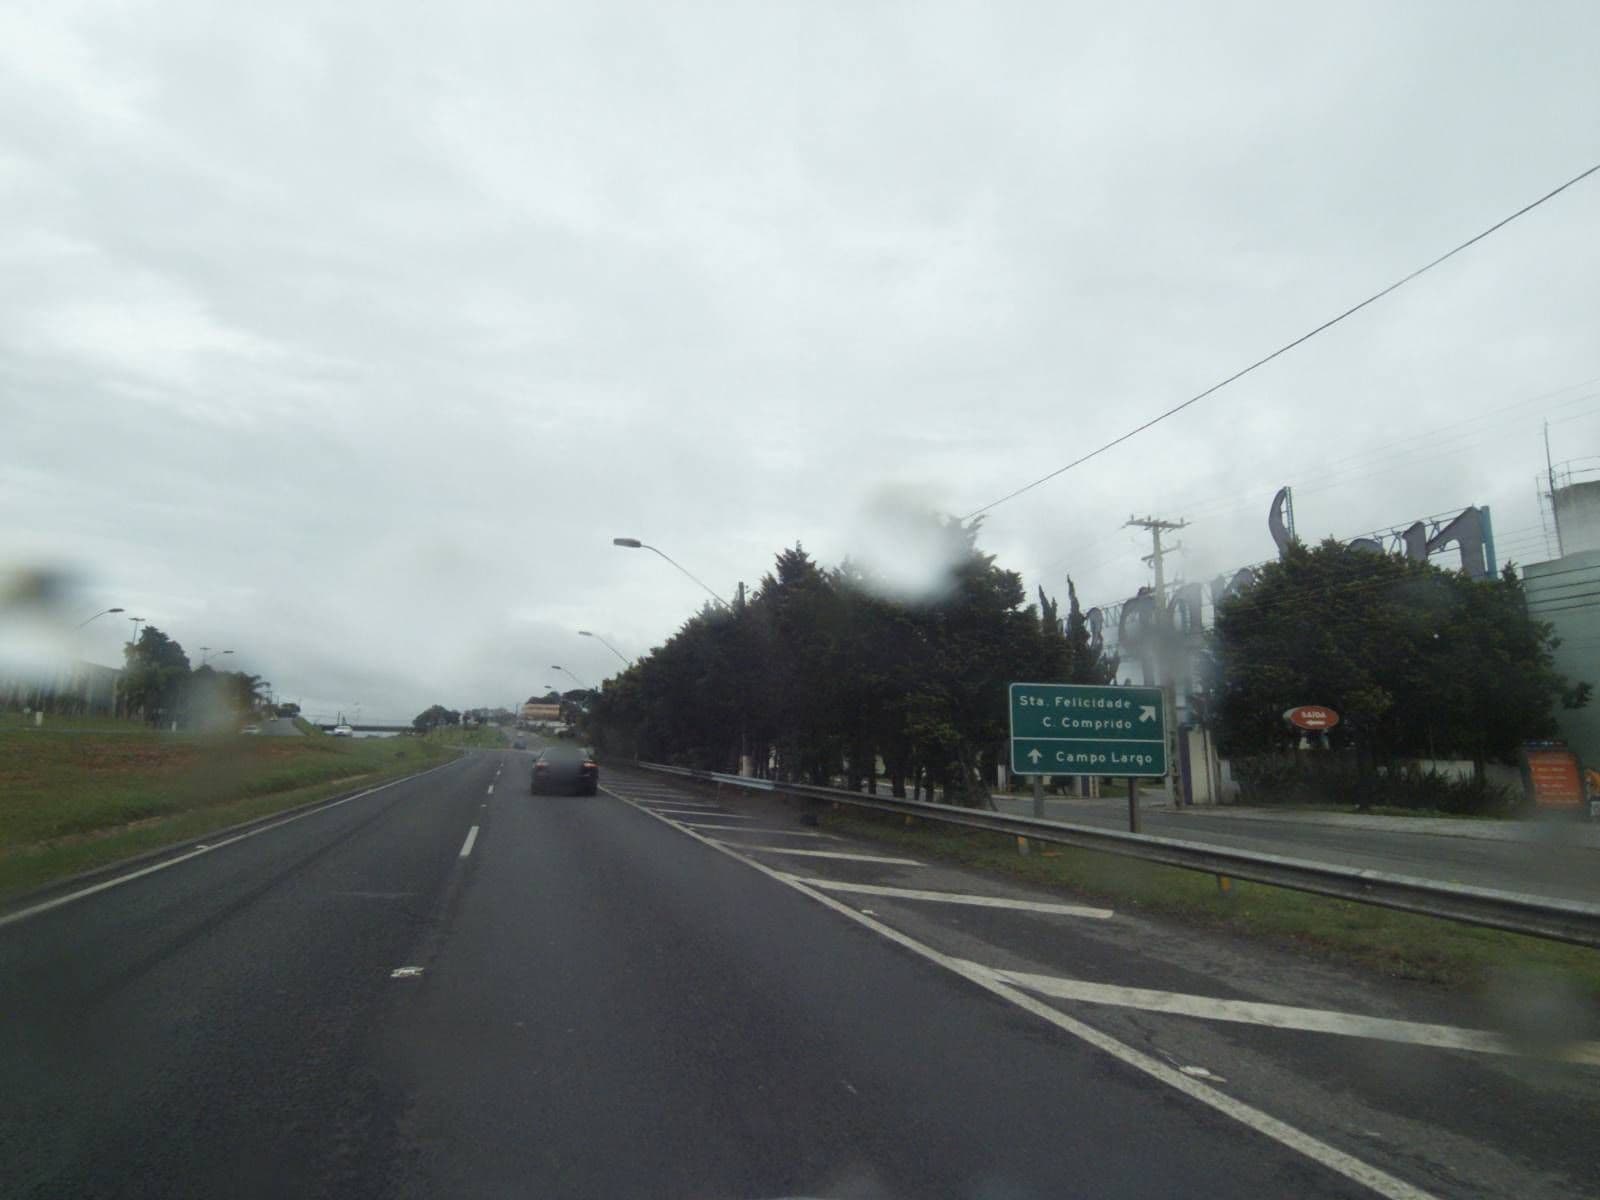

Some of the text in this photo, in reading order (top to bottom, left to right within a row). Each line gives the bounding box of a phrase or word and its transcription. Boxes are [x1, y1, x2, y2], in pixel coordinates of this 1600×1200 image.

[1019, 695, 1131, 709] Sta. Felicidade
[1062, 717, 1132, 730] Comprido
[1056, 751, 1152, 767] Campo Largo
